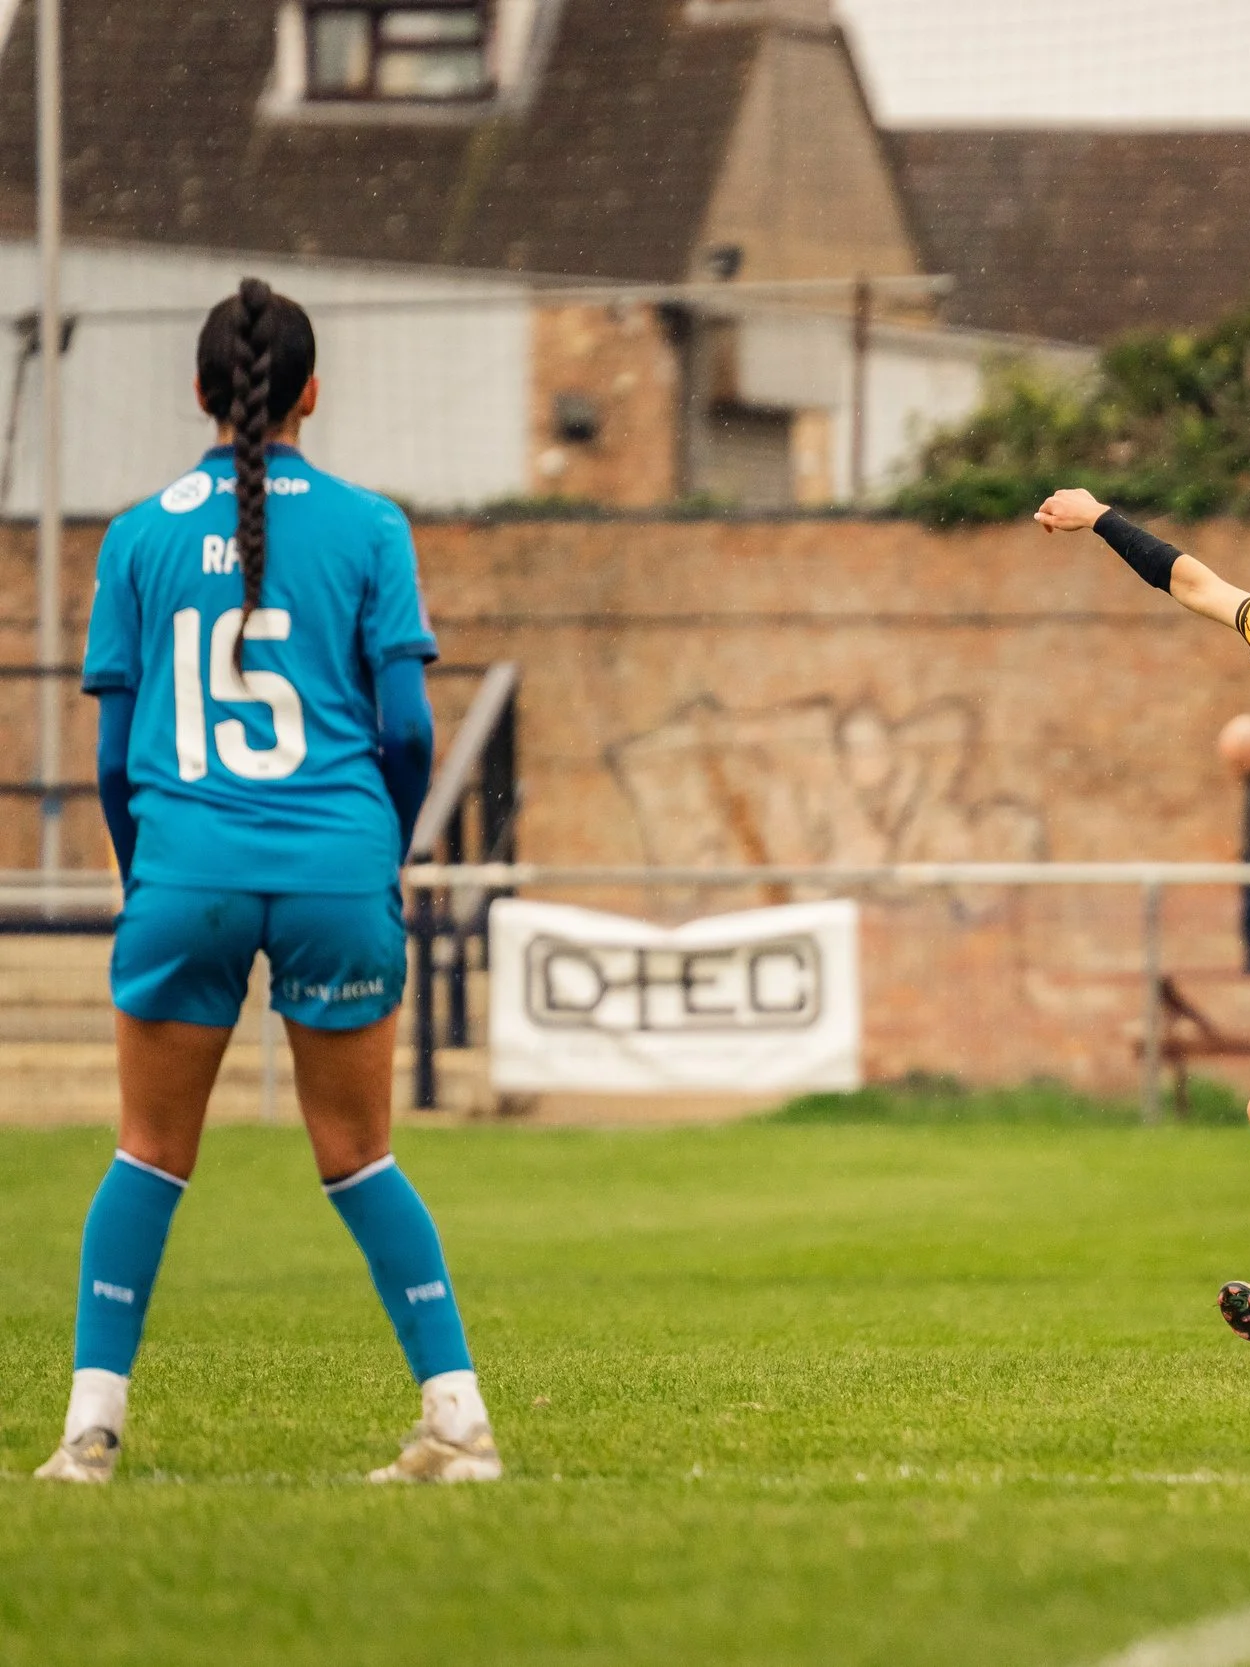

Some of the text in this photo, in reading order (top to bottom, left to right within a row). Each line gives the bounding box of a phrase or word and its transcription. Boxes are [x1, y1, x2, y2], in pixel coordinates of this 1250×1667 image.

[216, 476, 310, 496] XOP
[202, 534, 246, 575] RA
[173, 607, 307, 783] 15
